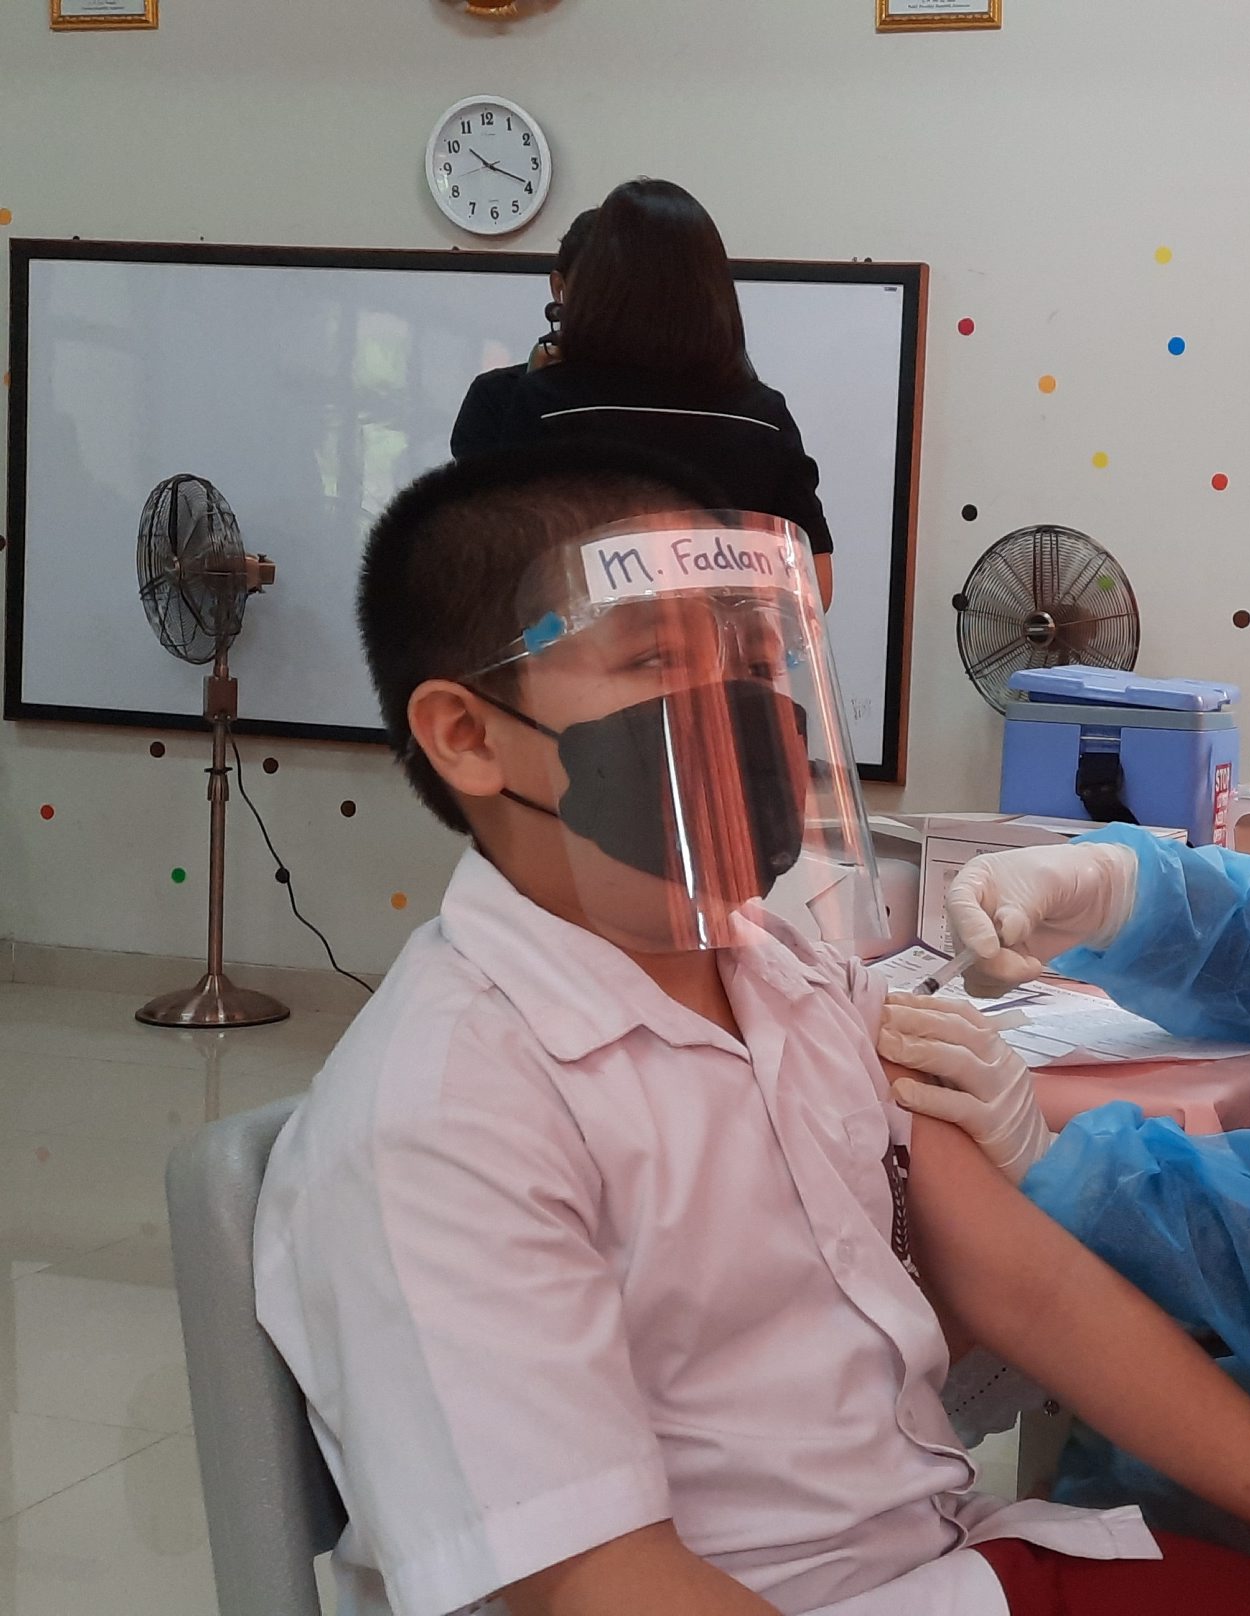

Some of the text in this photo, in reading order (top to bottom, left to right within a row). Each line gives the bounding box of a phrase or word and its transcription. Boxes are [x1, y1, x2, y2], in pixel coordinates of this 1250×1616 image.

[481, 112, 494, 126] 12
[506, 117, 512, 131] 1
[461, 120, 472, 134] 11
[522, 133, 531, 146] 2
[447, 140, 461, 154] 10
[443, 162, 452, 175] 9
[531, 157, 539, 170] 3
[451, 185, 460, 198] 8
[524, 181, 533, 194] 4
[469, 202, 476, 215] 7
[490, 206, 499, 220] 6
[511, 200, 520, 213] 5
[671, 536, 772, 577] Fadlan
